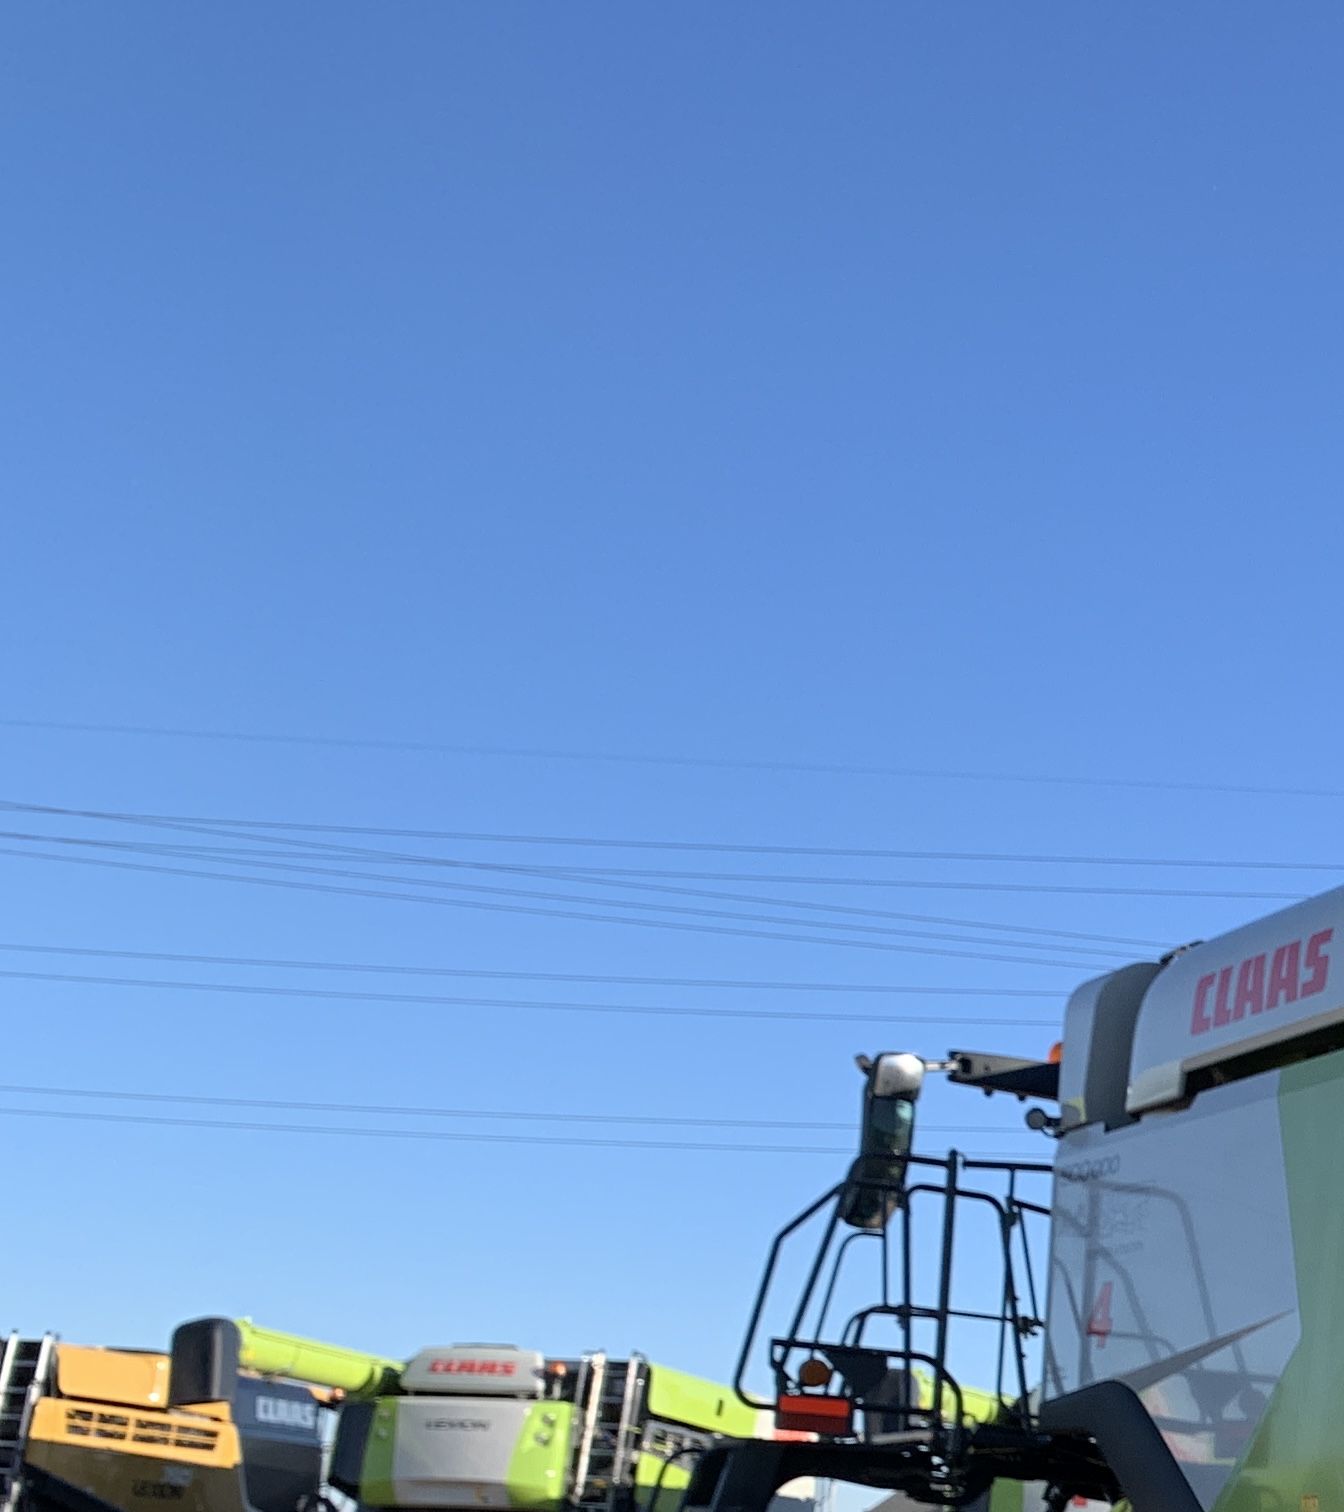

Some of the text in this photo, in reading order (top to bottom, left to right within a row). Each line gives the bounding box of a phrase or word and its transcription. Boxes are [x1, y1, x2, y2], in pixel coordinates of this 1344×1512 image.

[1190, 928, 1334, 1036] CLAAS
[1086, 1281, 1114, 1349] 4
[429, 1358, 518, 1377] CLAAS
